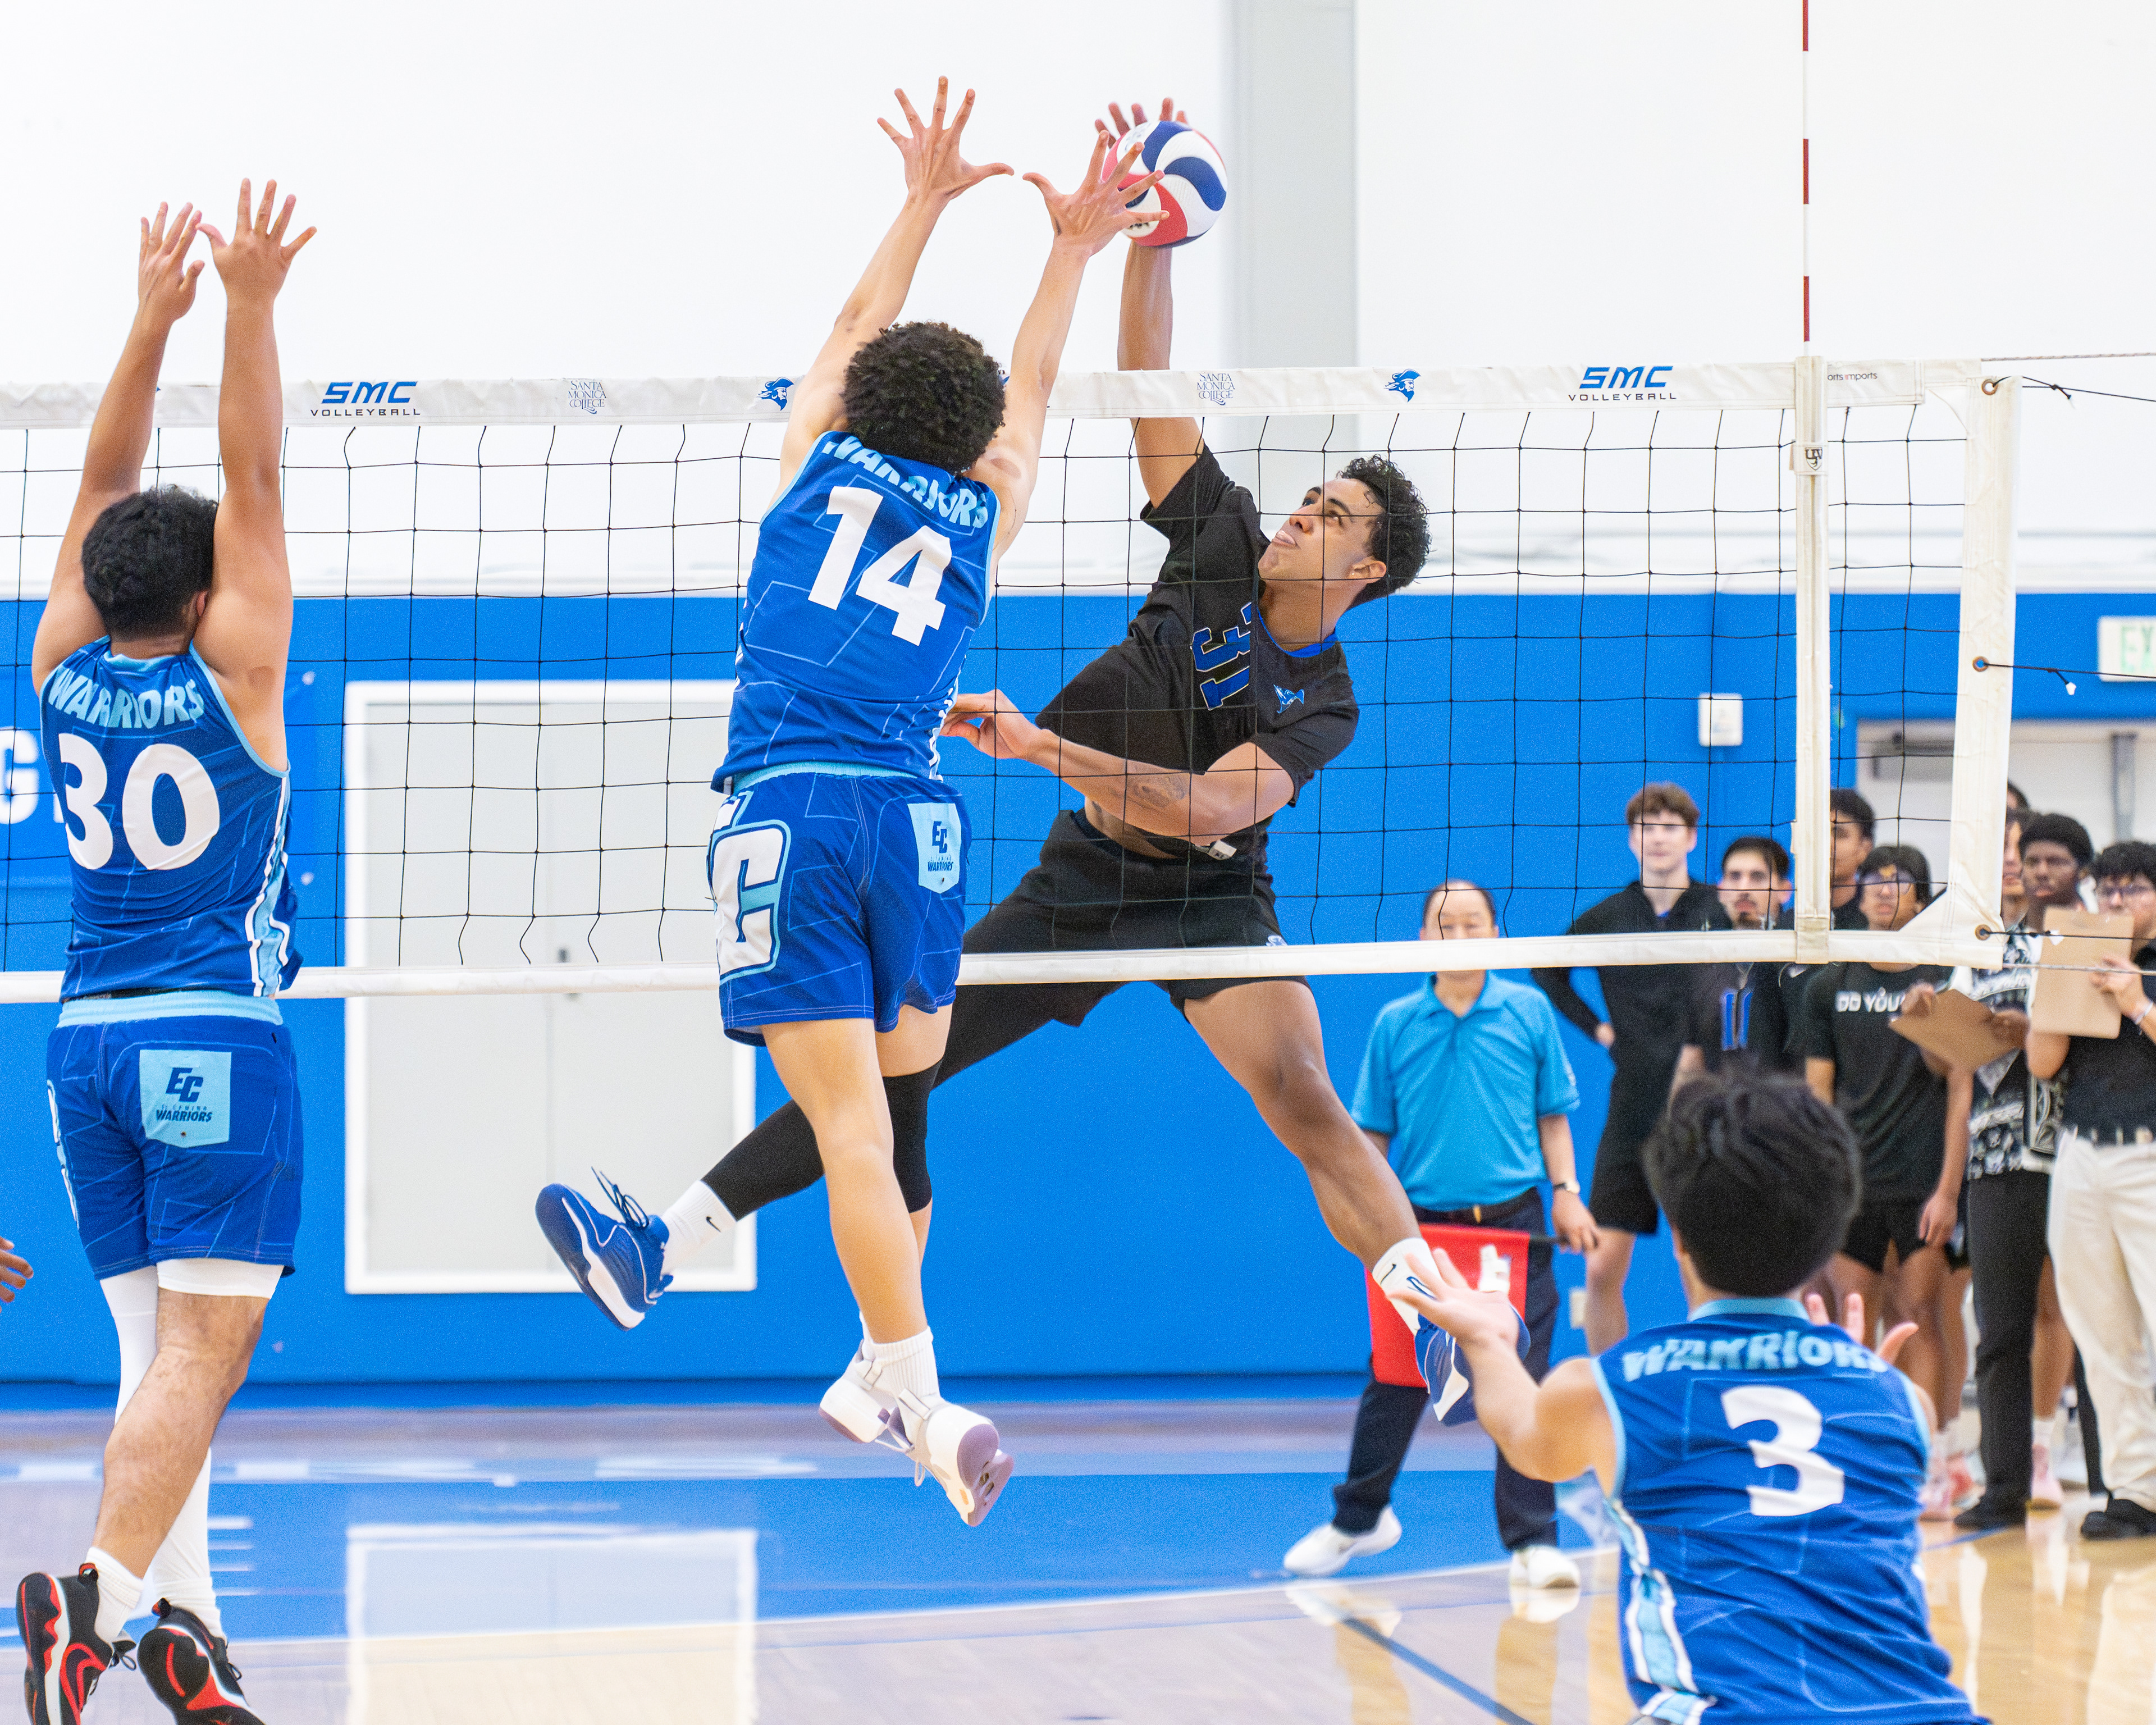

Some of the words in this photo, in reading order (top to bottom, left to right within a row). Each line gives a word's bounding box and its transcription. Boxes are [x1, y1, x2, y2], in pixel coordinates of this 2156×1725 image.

[570, 380, 603, 390] SANTA
[1199, 373, 1232, 382] SANTA
[1579, 366, 1674, 389] SMC
[321, 381, 418, 404] SMC
[1196, 382, 1235, 390] MONICA
[568, 390, 606, 399] MONICA
[1198, 390, 1234, 405] COLLEGE
[1568, 393, 1677, 401] VOLLEYBALL
[310, 408, 421, 417] VOLLEYBALL
[569, 399, 605, 414] COLLEGE
[807, 486, 952, 646] 14
[48, 664, 204, 729] WARRIORS
[58, 733, 220, 870] 30
[932, 820, 948, 854] EC
[165, 1067, 204, 1102] EC
[156, 1110, 213, 1122] WARRIORS
[1721, 1385, 1845, 1517] 3
